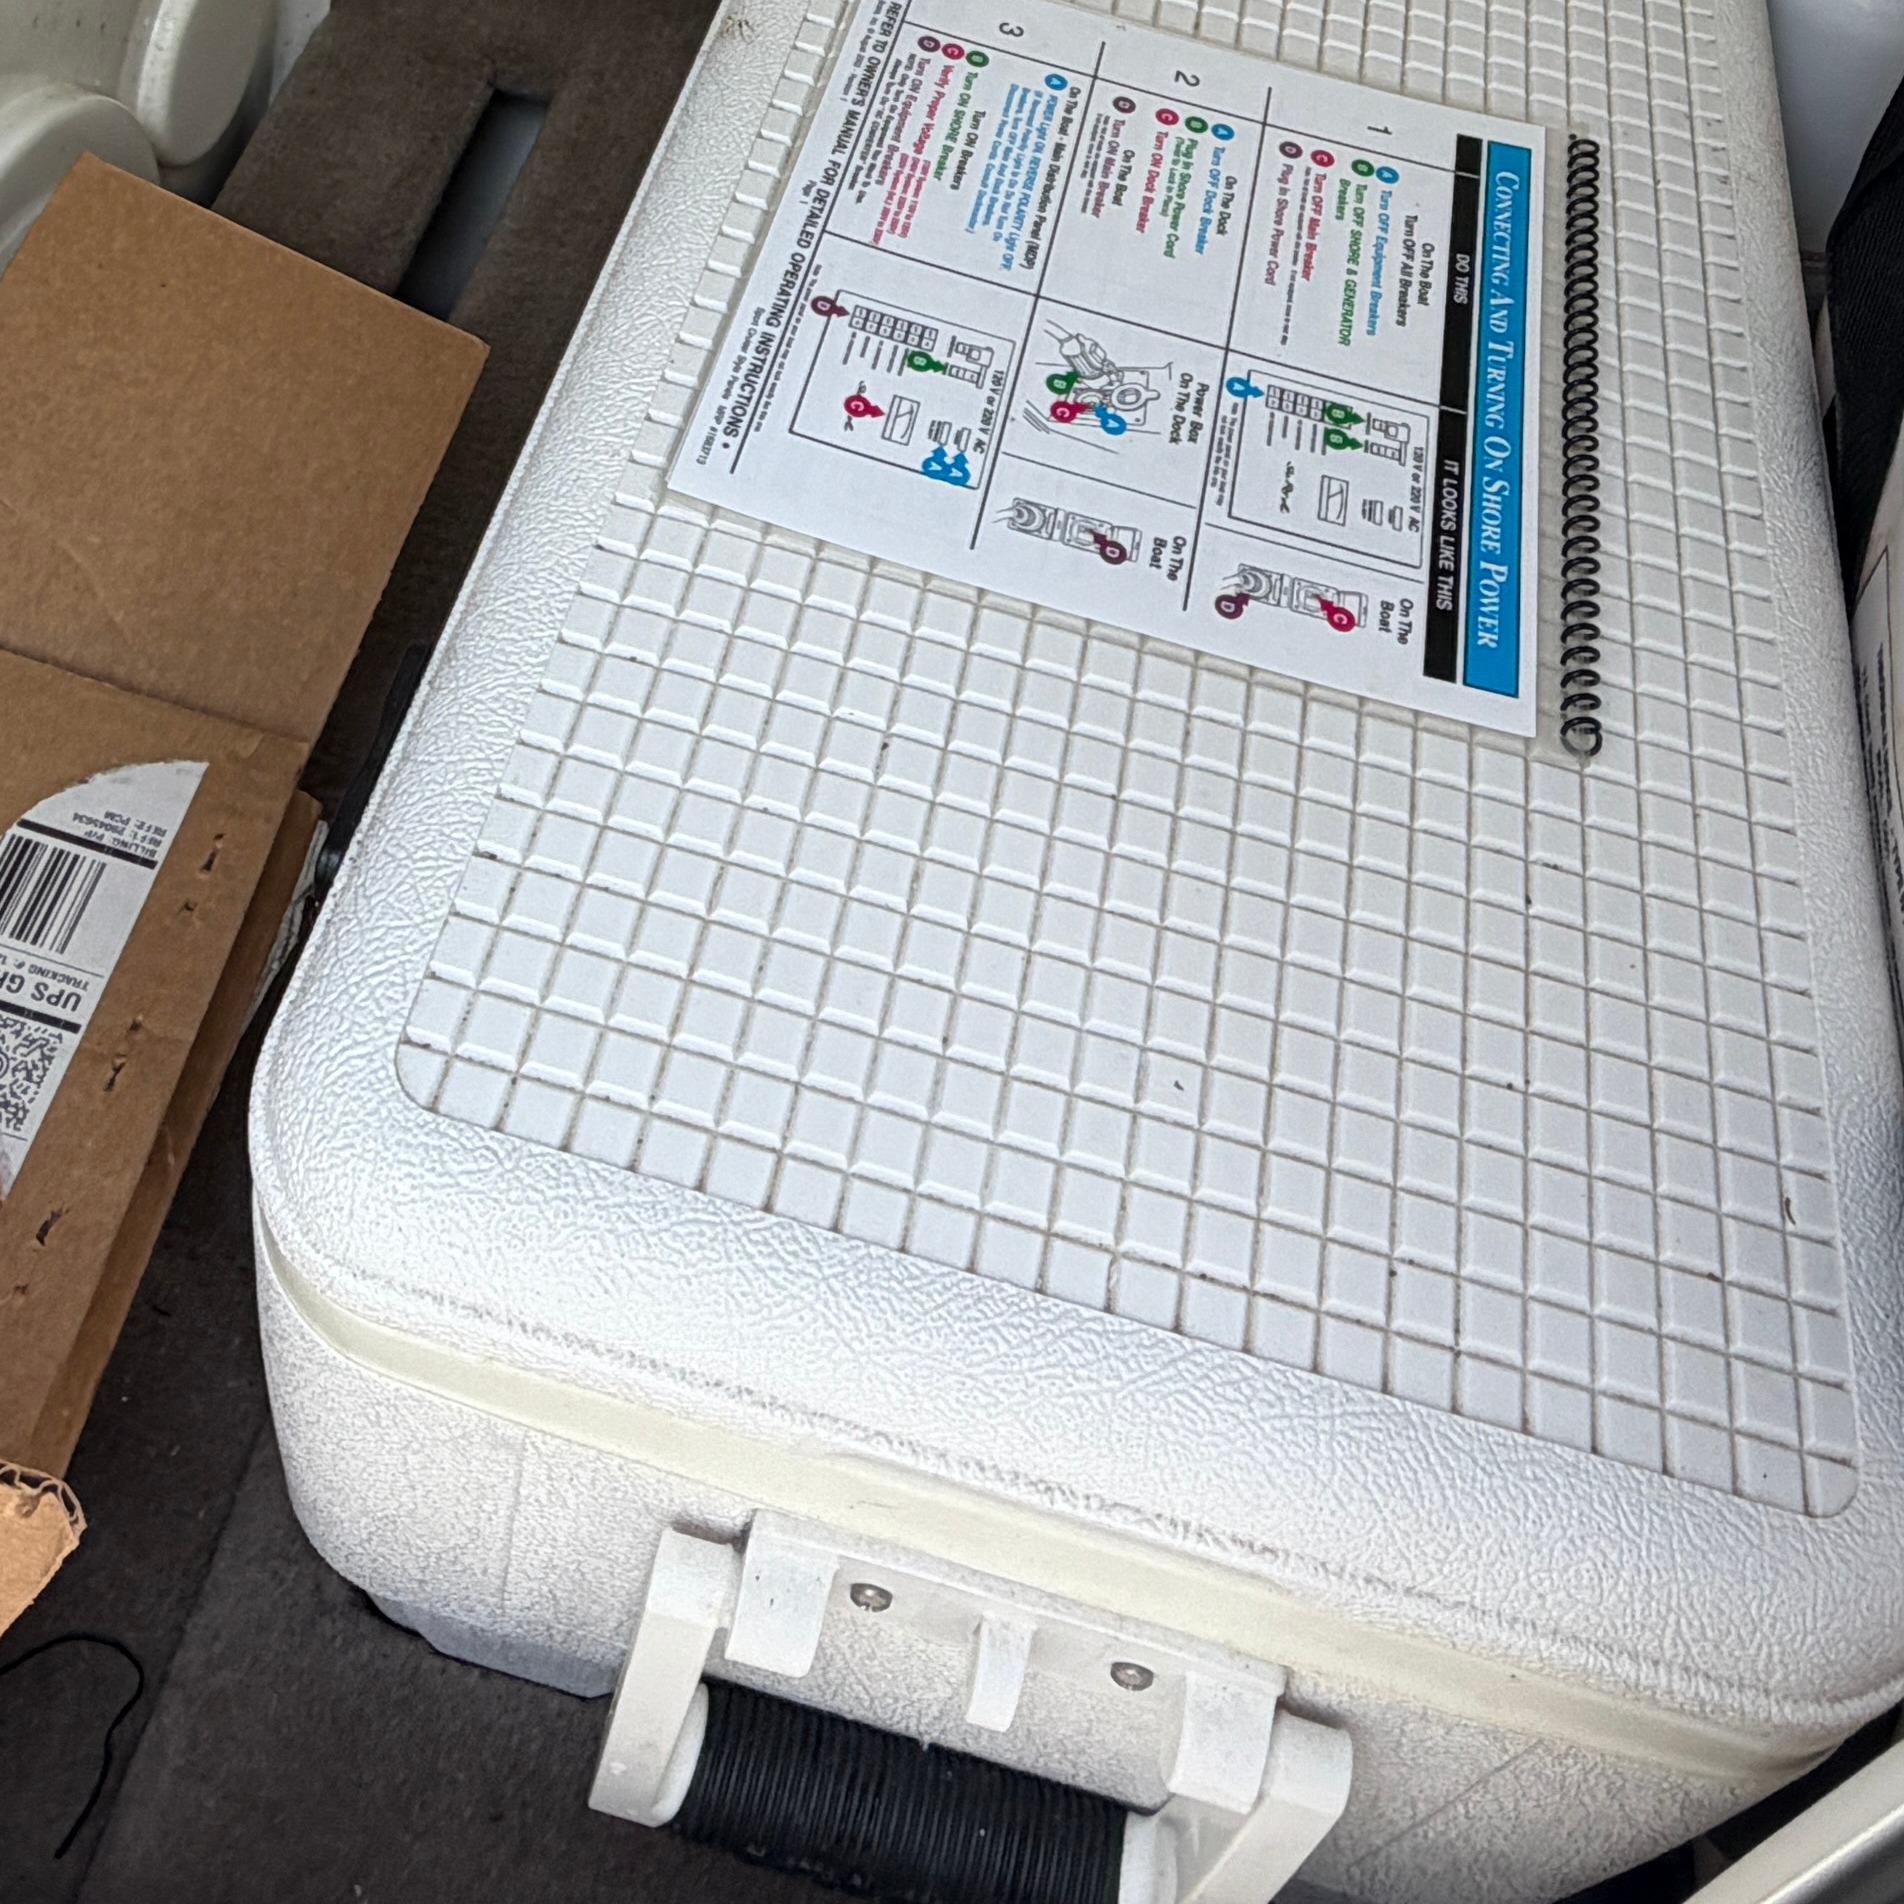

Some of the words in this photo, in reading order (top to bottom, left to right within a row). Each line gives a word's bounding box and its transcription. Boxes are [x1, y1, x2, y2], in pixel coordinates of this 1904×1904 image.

[878, 0, 903, 38] REFER
[997, 21, 1025, 38] 3
[870, 38, 889, 54] TO
[850, 55, 882, 107] OWNER'S
[1173, 69, 1201, 87] 2
[830, 108, 861, 155] MANUAL
[1366, 124, 1391, 136] 1
[1120, 148, 1136, 164] On
[818, 158, 842, 186] FOR
[1116, 163, 1133, 182] The
[1223, 174, 1238, 191] On
[1110, 181, 1128, 207] Boat
[1219, 191, 1235, 210] The
[795, 187, 831, 249] DETAILED
[1215, 209, 1232, 236] Dock
[1403, 214, 1419, 237] Turn
[1490, 170, 1519, 286] CONNECTING
[1401, 237, 1416, 262] OFF
[1420, 241, 1435, 259] On
[1454, 252, 1471, 273] DO
[1399, 260, 1414, 278] All
[1418, 259, 1434, 279] The
[764, 251, 806, 328] OPERATING
[1394, 277, 1413, 327] Breakers
[1416, 278, 1433, 307] Boat
[1452, 275, 1470, 305] THIS
[1488, 288, 1514, 333] AND
[721, 330, 776, 438] INSTRUCTIONS
[1178, 371, 1194, 390] On
[1484, 340, 1514, 429] TURNING
[1173, 390, 1191, 413] The
[1191, 381, 1210, 418] Power
[1167, 413, 1187, 445] Dock
[1186, 419, 1204, 444] Box
[1443, 458, 1460, 476] IT
[1483, 435, 1511, 472] ON
[1439, 477, 1458, 531] LOOKS
[1479, 475, 1509, 554] SHORE
[1147, 535, 1168, 570] Boat
[1170, 534, 1187, 555] On
[1437, 534, 1455, 571] LIKE
[1165, 557, 1184, 582] The
[1434, 575, 1454, 611] THIS
[1476, 560, 1508, 648] POWER
[1377, 598, 1395, 633] Boat
[1398, 597, 1414, 618] On
[1396, 620, 1413, 645] The
[27, 964, 89, 991] TRACKING
[30, 981, 81, 1011] UPS
